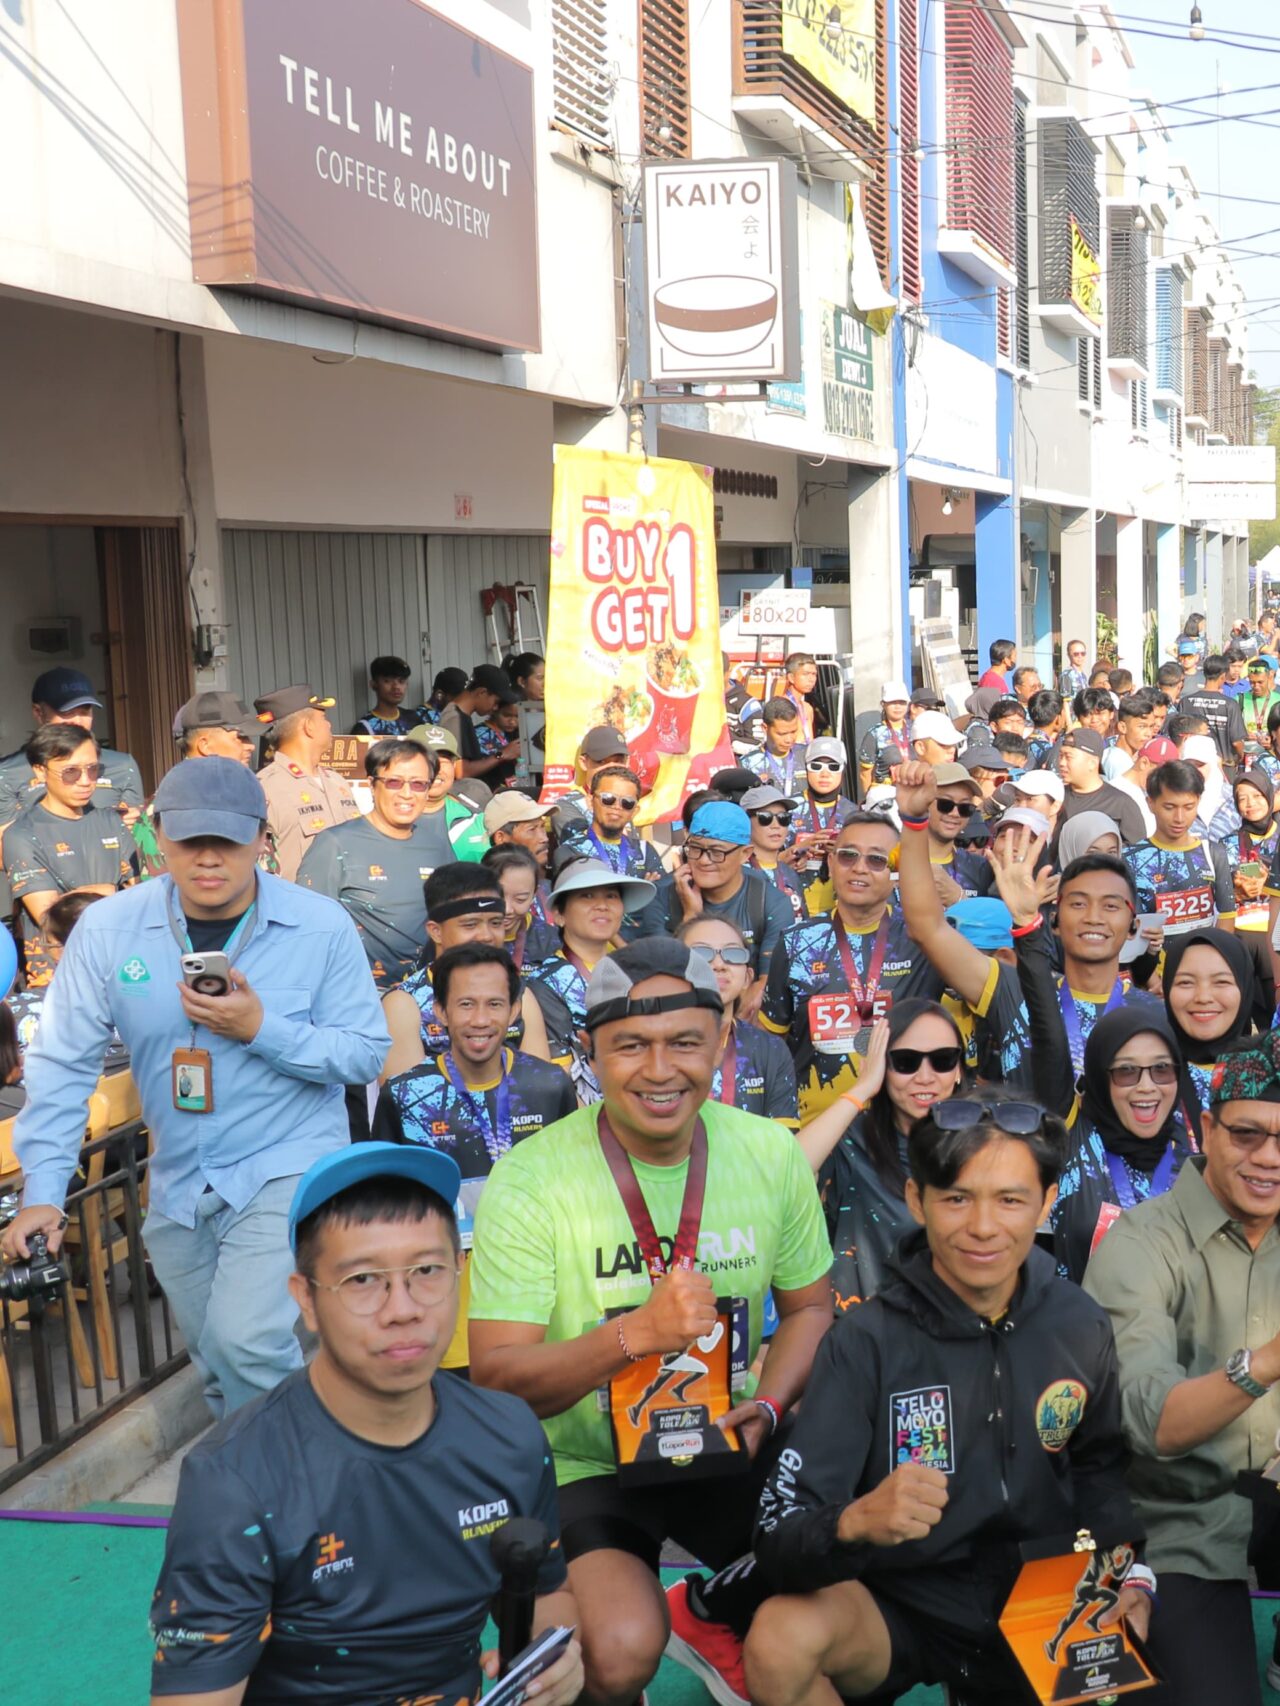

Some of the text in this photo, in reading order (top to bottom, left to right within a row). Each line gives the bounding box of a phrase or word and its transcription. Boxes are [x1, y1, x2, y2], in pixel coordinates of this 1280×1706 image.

[279, 54, 511, 198] TELL ME ABOUT
[315, 145, 491, 239] COFFEE & ROASTERY
[666, 181, 762, 207] KAIYO
[839, 313, 867, 355] JUAL
[583, 516, 661, 584] BUY
[661, 523, 696, 640] 1
[591, 586, 669, 651] GET
[753, 607, 807, 623] 80x20
[1161, 893, 1211, 919] 5225
[883, 960, 911, 970] KOPO
[816, 1001, 887, 1030] 525
[744, 1076, 764, 1088] KOP
[511, 1114, 543, 1125] KOPO
[701, 1255, 757, 1274] RUNNERS
[897, 1391, 945, 1414] TELO
[660, 1413, 682, 1423] KOPO
[897, 1410, 946, 1432] MOYO
[897, 1424, 947, 1447] FEST
[897, 1443, 949, 1465] 2024
[458, 1498, 509, 1528] KOPO
